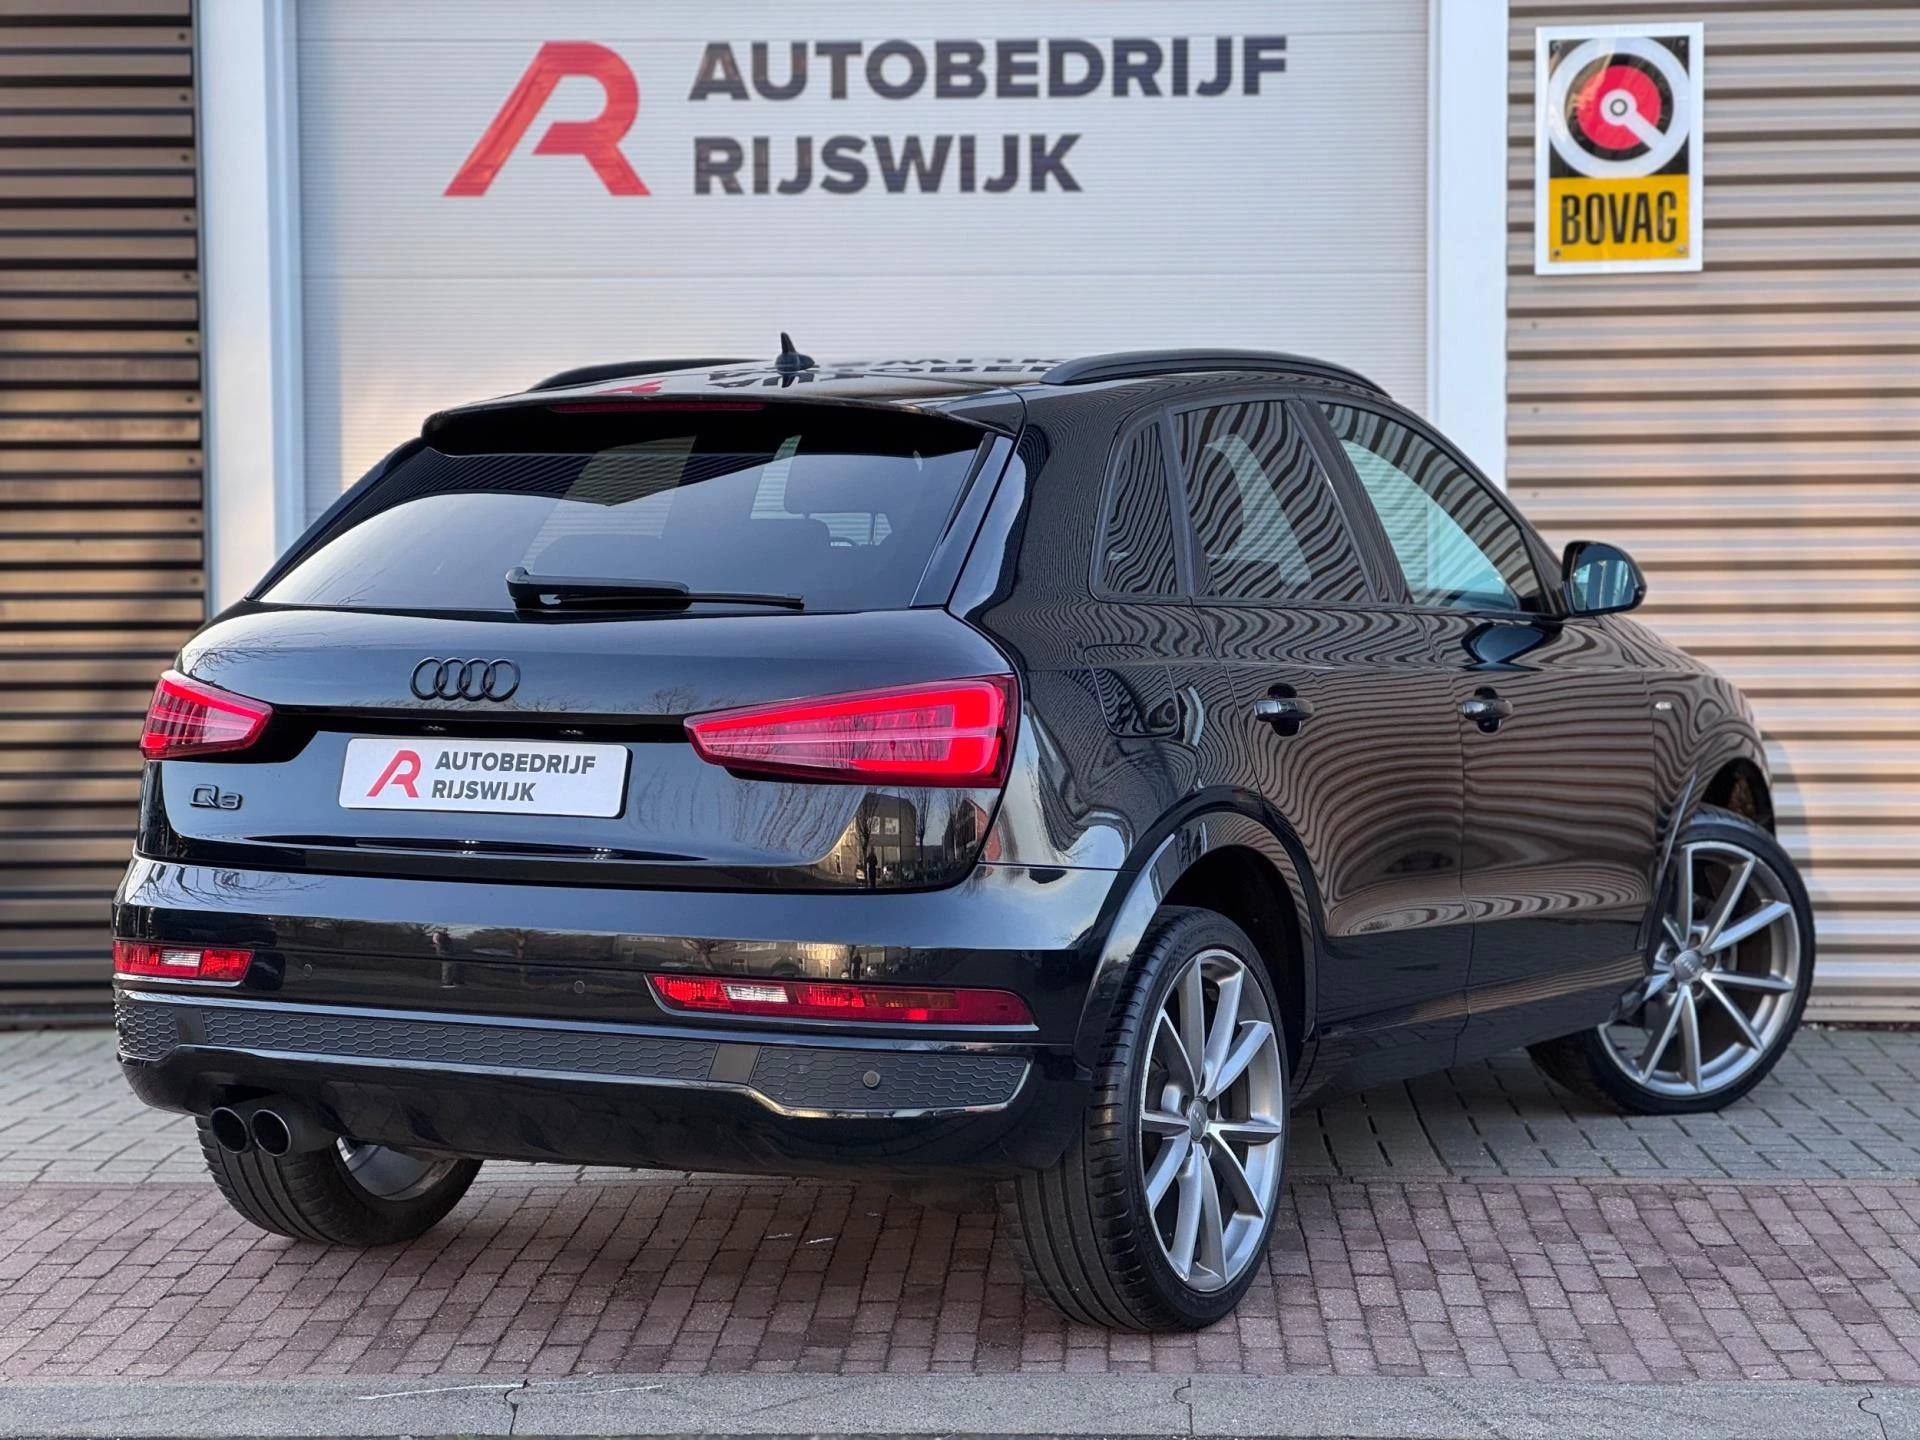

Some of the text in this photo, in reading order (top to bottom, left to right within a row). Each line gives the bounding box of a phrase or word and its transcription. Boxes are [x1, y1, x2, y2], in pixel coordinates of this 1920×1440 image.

[689, 36, 1288, 101] AUTOBEDRIJF
[693, 134, 1083, 195] RIJSWIJK
[1561, 190, 1677, 245] BOVAG
[435, 751, 596, 775] AUTOBEDRIJF
[190, 783, 242, 810] Q3
[431, 779, 535, 802] RIJSWIJK
